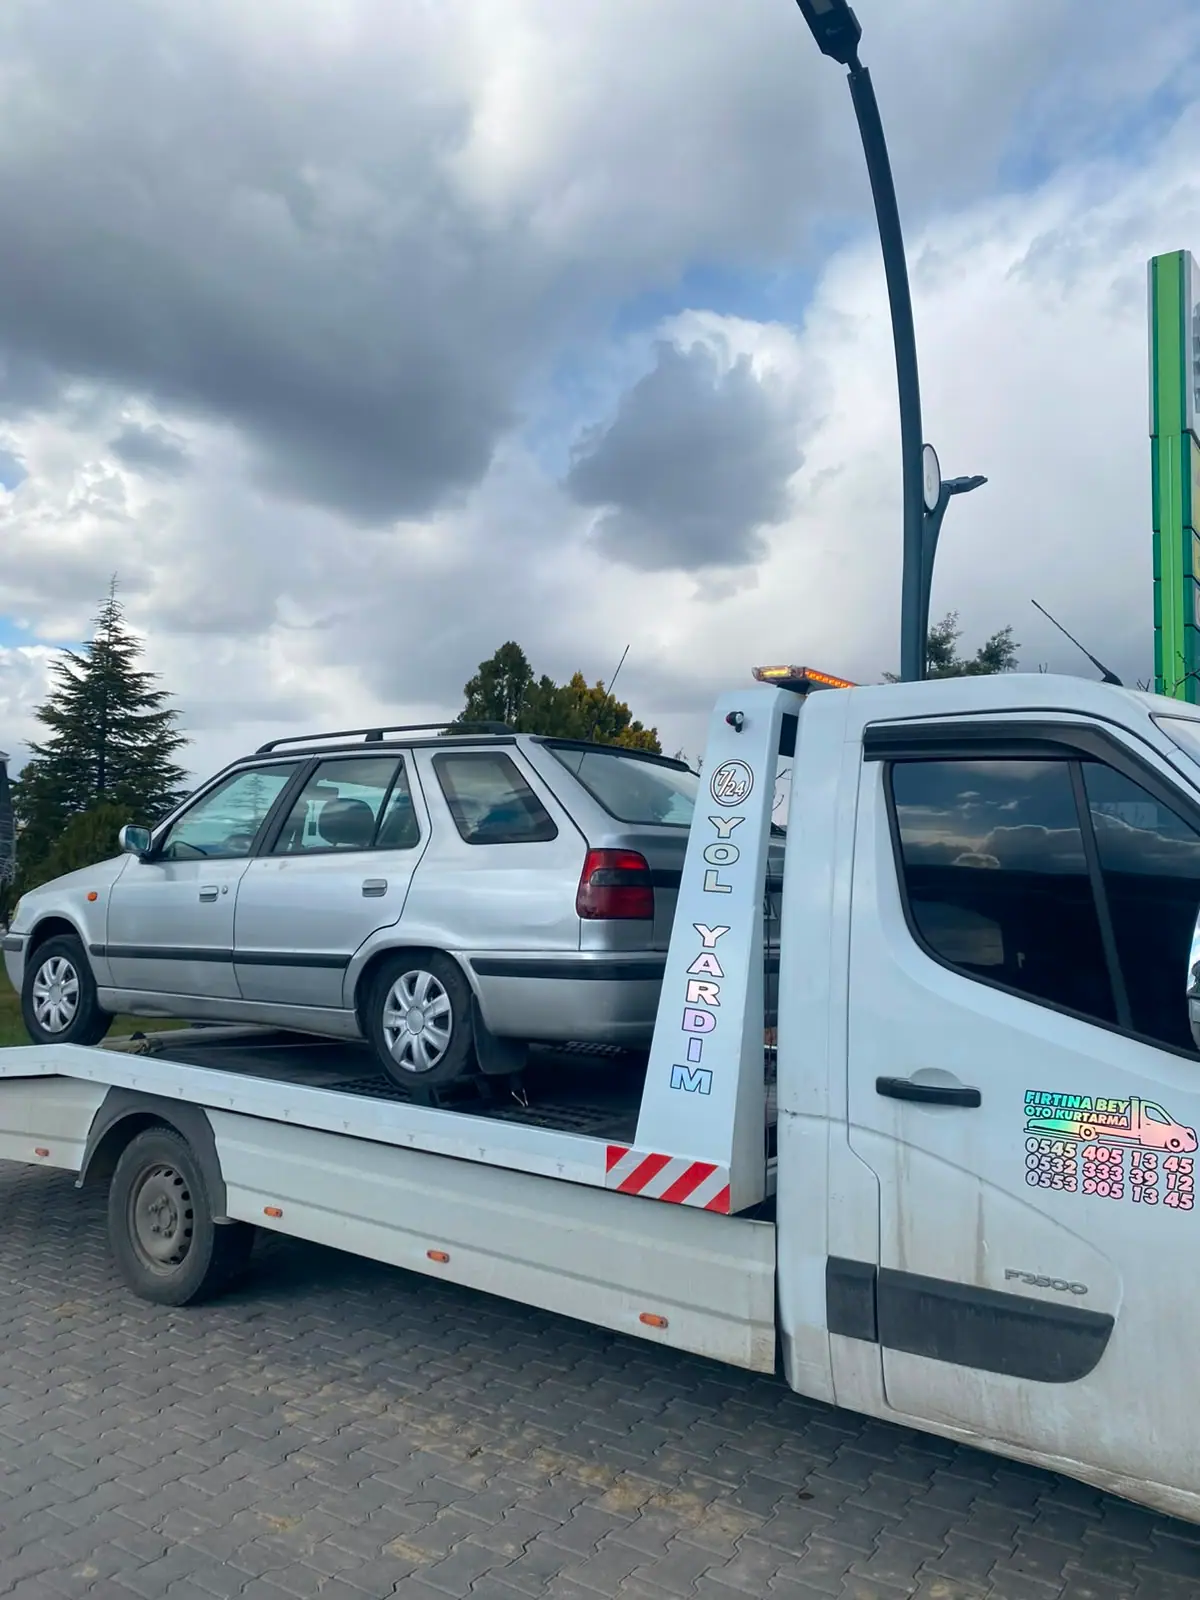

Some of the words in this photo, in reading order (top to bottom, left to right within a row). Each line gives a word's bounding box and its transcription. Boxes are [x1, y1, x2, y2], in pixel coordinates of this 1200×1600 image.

[718, 769, 746, 797] 7/24
[703, 816, 746, 894] YOL
[670, 923, 731, 1096] YARDIM
[1024, 1090, 1092, 1111] FIRTINA
[1095, 1098, 1131, 1114] BEY
[1024, 1105, 1052, 1118] OTO
[1054, 1109, 1129, 1128] KURTARMA
[1025, 1137, 1077, 1158] 0545
[1081, 1145, 1124, 1165] 405
[1131, 1151, 1158, 1170] 13
[1163, 1156, 1194, 1175] 45
[1025, 1153, 1078, 1176] 0532
[1082, 1161, 1124, 1182] 333
[1129, 1167, 1159, 1187] 39
[1166, 1173, 1195, 1193] 12
[1025, 1170, 1078, 1192] 0553
[1082, 1178, 1124, 1199] 905
[1131, 1185, 1159, 1205] 13
[1163, 1190, 1195, 1210] 45
[1005, 1268, 1088, 1295] F3500
